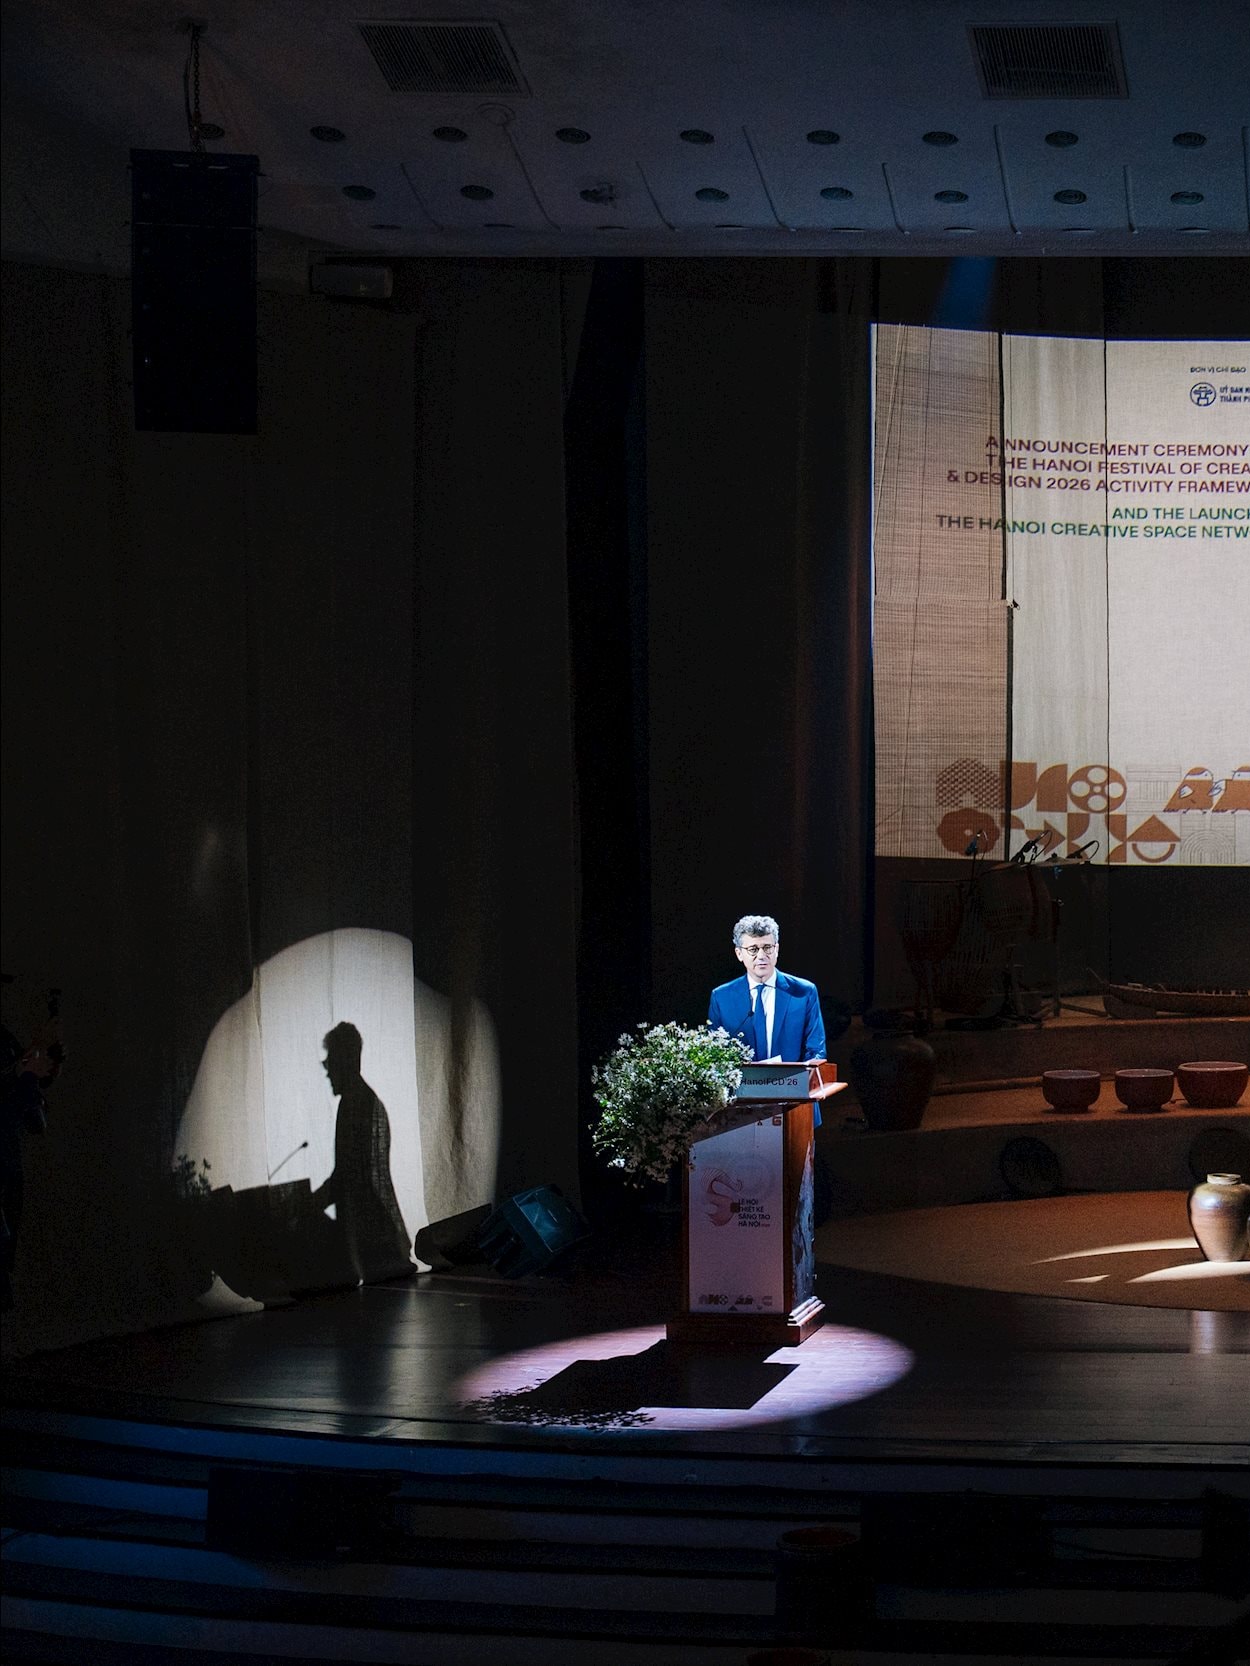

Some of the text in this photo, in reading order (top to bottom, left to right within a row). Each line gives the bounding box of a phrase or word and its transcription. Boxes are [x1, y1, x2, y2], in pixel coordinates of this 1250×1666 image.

[986, 436, 1149, 456] ANNOUNCEMENT
[1153, 444, 1248, 457] CEREMONY
[986, 453, 1028, 470] THE
[1033, 458, 1092, 473] HANOI
[1099, 462, 1176, 475] FESTIVAL
[1180, 463, 1202, 475] OF
[947, 470, 959, 483] &
[965, 471, 1042, 488] DESIGN
[1046, 477, 1091, 491] 2026
[1095, 480, 1173, 493] ACTIVITY
[1112, 508, 1148, 520] AND
[1152, 508, 1184, 520] THE
[936, 515, 975, 529] THE
[979, 517, 1045, 535] HANOI
[1051, 522, 1138, 538] CREATIVE
[1143, 526, 1196, 538] SPACE
